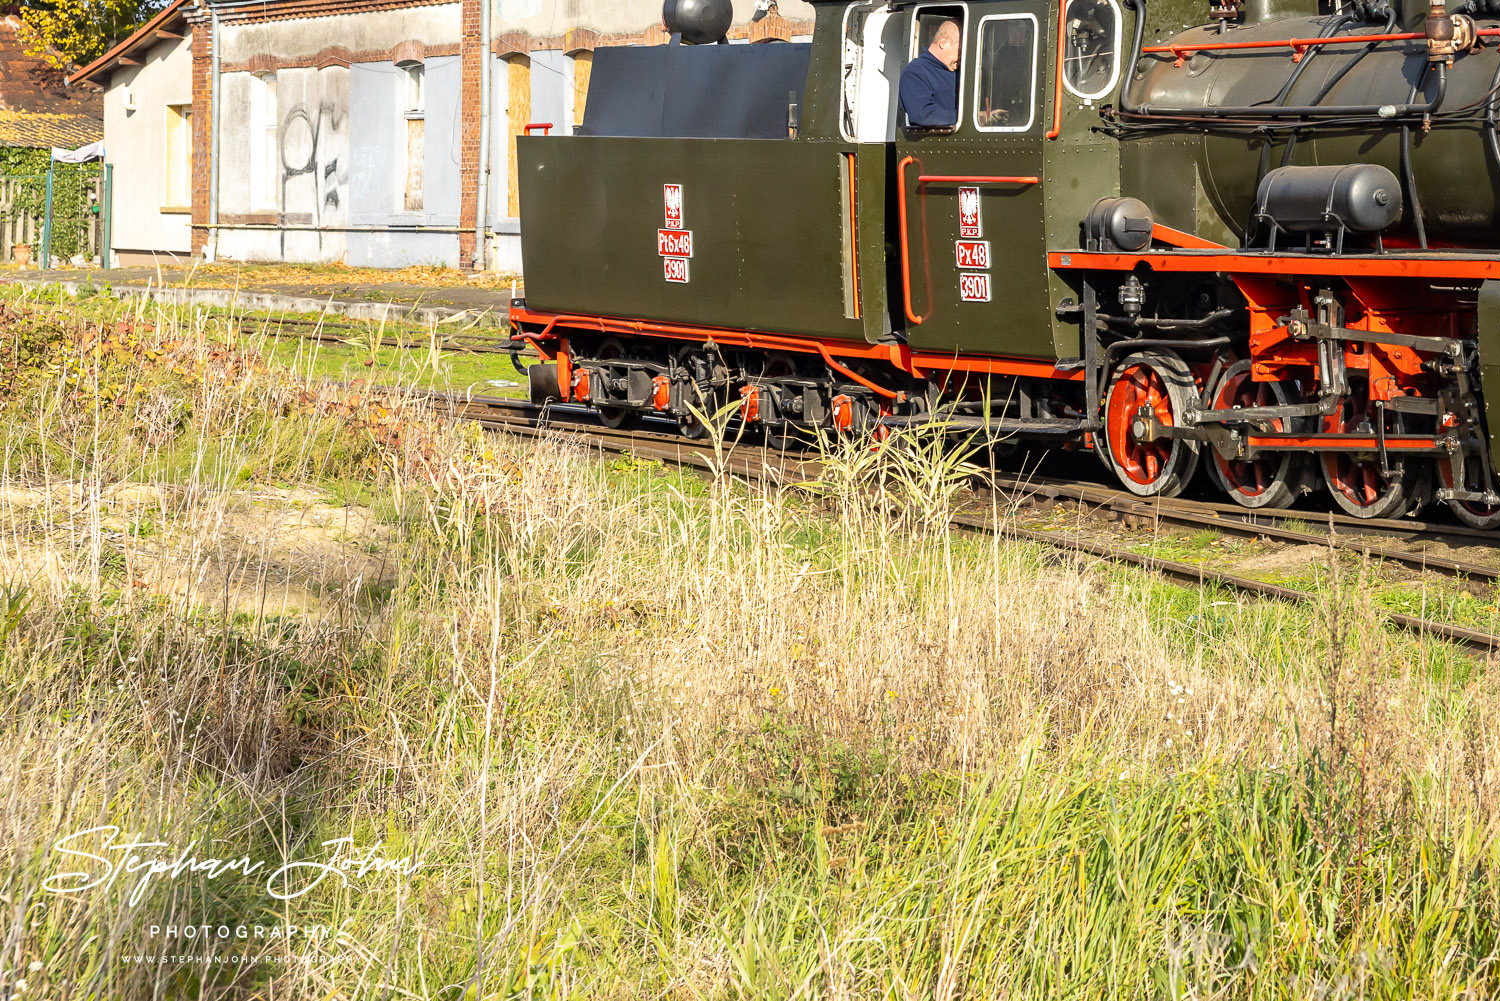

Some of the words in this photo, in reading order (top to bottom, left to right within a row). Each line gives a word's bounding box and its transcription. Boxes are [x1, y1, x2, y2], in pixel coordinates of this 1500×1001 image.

[660, 232, 690, 254] Pt6x48
[958, 244, 986, 266] Px48
[665, 259, 686, 279] 3901
[961, 276, 986, 298] 3901
